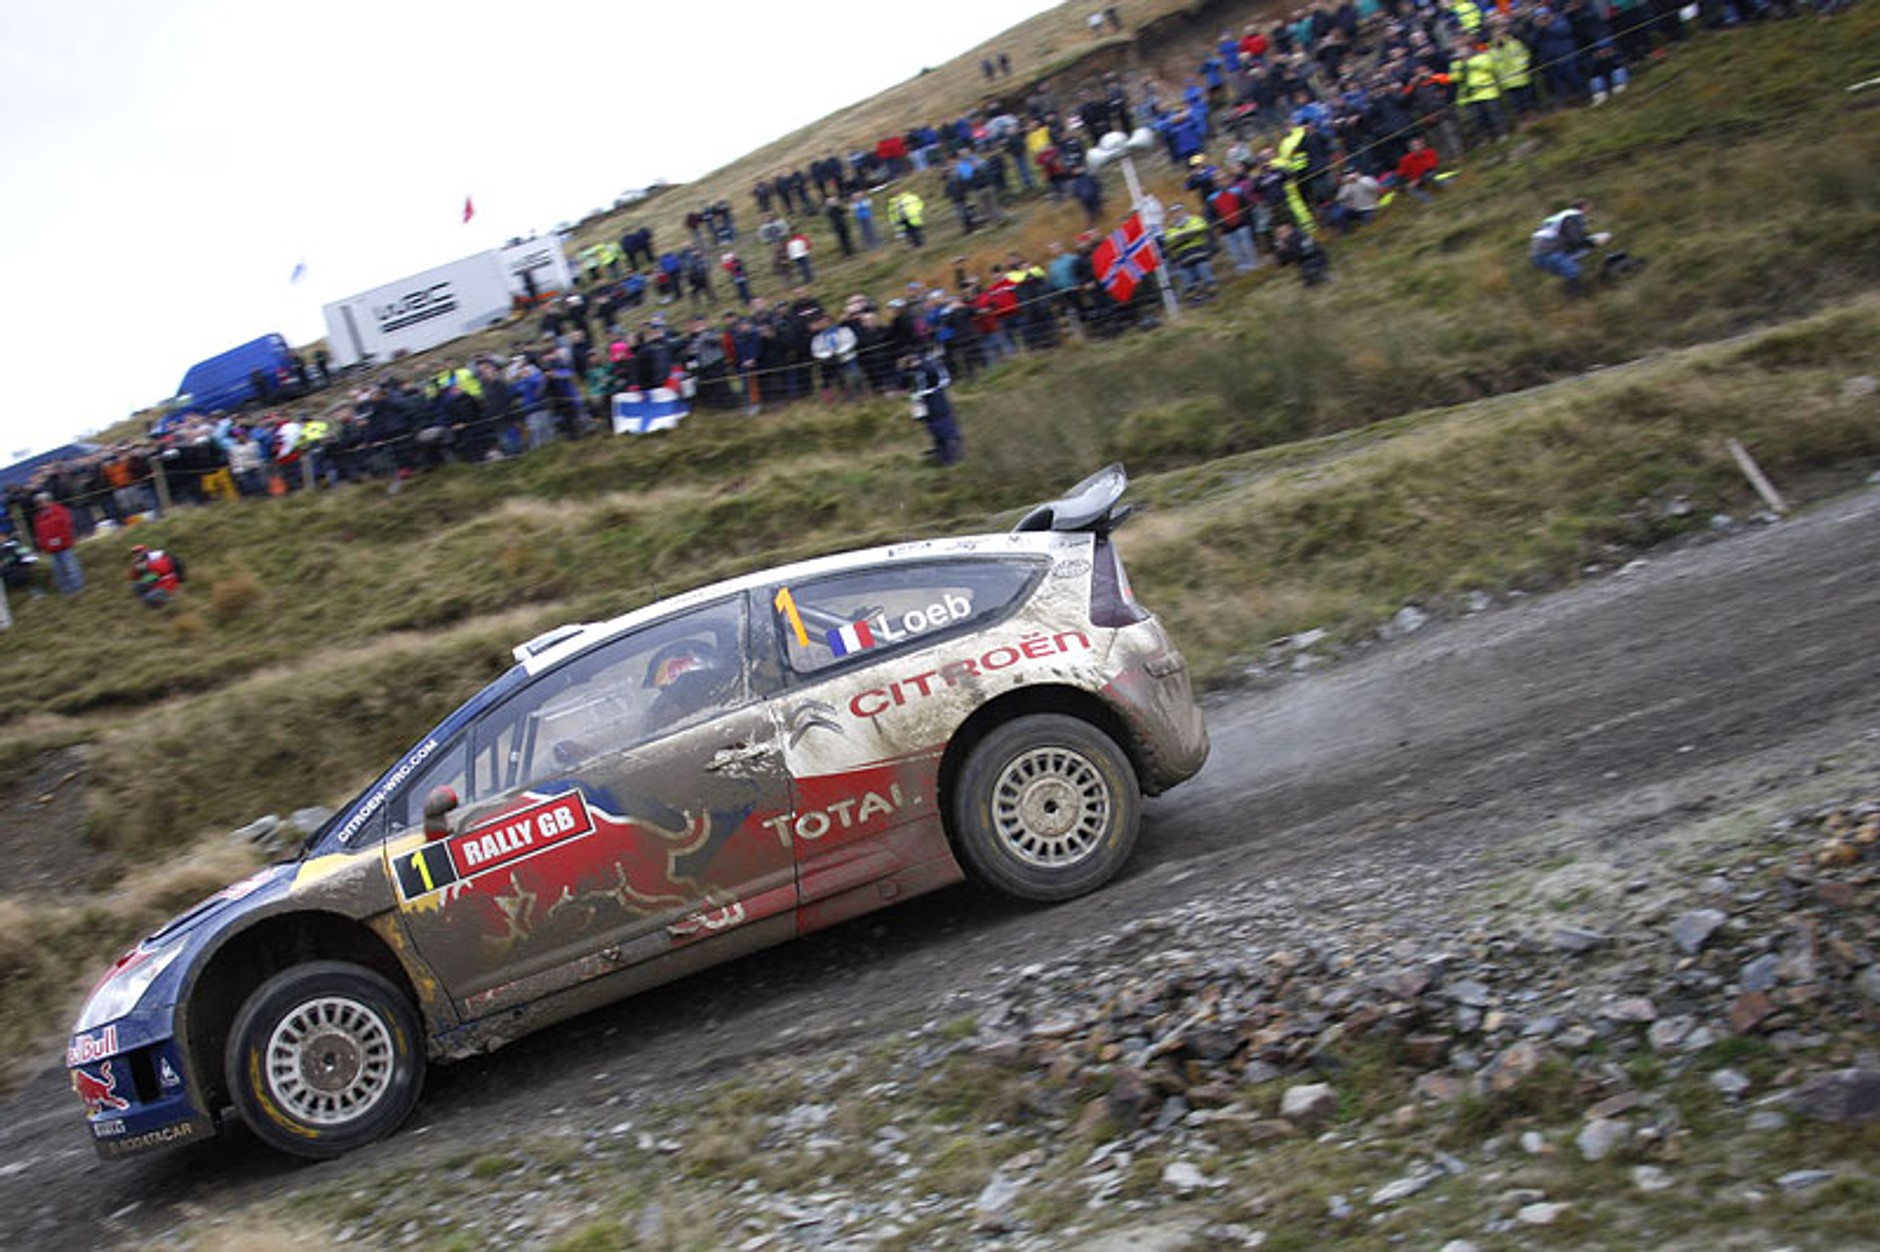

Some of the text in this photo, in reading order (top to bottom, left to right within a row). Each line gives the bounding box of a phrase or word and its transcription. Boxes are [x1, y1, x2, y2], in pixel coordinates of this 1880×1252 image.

[372, 281, 456, 321] WRC
[775, 586, 972, 647] 1 Loeb
[850, 631, 1091, 718] CITROËN
[411, 806, 575, 891] 1 RALLY GB
[81, 1024, 119, 1062] Bull
